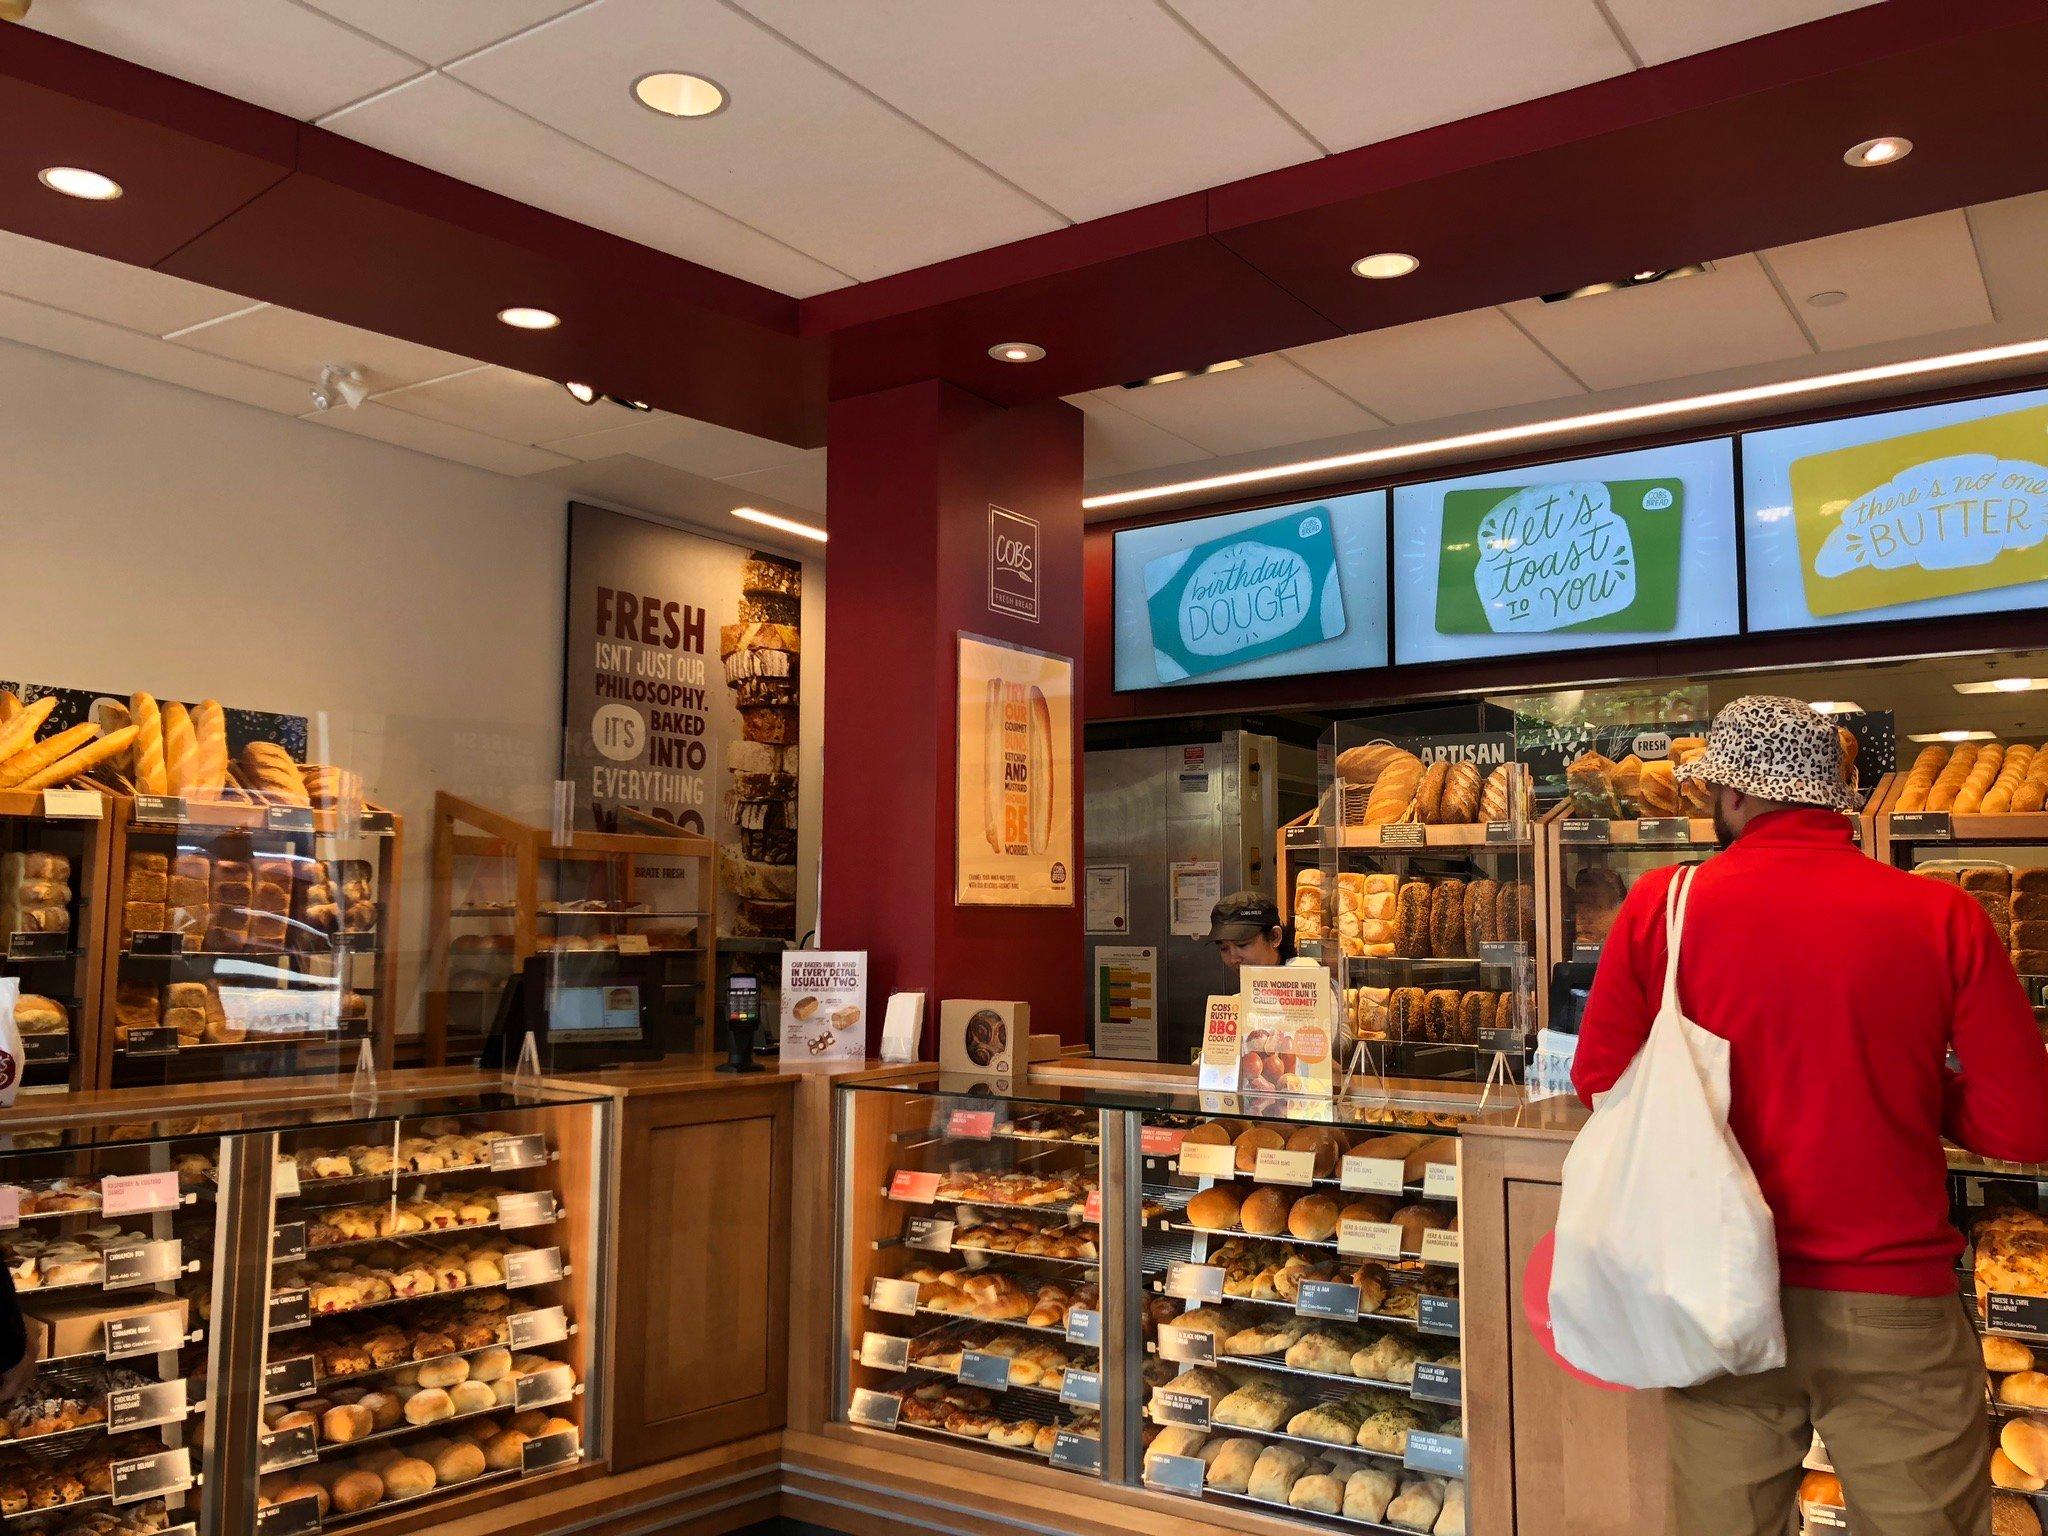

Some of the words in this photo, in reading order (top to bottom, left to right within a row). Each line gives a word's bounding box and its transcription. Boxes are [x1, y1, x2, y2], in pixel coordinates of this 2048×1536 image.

[1648, 492, 1667, 500] COBS
[1851, 479, 1946, 528] there's
[1953, 472, 1997, 493] no
[1645, 499, 1669, 507] BREAD
[1486, 490, 1604, 562] let's
[1869, 498, 2032, 558] BUTTER
[996, 535, 1033, 571] COBS
[1491, 522, 1614, 601] toast
[1192, 556, 1301, 602] birthday
[995, 592, 1014, 605] FRESH
[1014, 597, 1033, 611] BREAD
[1506, 599, 1530, 615] TO
[1188, 580, 1302, 642] DOUGH
[596, 586, 706, 655] FRESH
[595, 641, 632, 673] ISN'T
[637, 650, 673, 681] JUST
[677, 657, 705, 686] OUR
[595, 672, 709, 711] PHILOSOPHY.
[1005, 702, 1027, 721] OUR
[604, 717, 635, 748] IT'S
[651, 710, 705, 736] BAKED
[1004, 721, 1027, 733] GOURMET
[1005, 732, 1027, 752] BUNS
[1637, 739, 1667, 751] FRESH
[650, 736, 707, 771] INTO
[1420, 742, 1506, 764] ARTISAN
[1004, 763, 1027, 783] AND
[592, 765, 704, 805] EVERYTHING
[1005, 805, 1027, 844] BE
[791, 968, 799, 976] IN
[803, 968, 827, 976] EVERY
[830, 968, 859, 976] DETAIL.
[791, 978, 830, 987] USUALLY
[833, 978, 859, 987] TWO.
[1270, 981, 1299, 989] WONDER
[1261, 989, 1294, 997] GOURMET
[1296, 990, 1309, 998] BUN
[1311, 990, 1317, 998] IS
[1211, 1003, 1230, 1011] COBS
[1253, 997, 1277, 1005] CALLED
[1279, 998, 1318, 1007] GOURMET?
[1210, 1012, 1238, 1020] RUSTY'S
[1209, 1020, 1237, 1035] BBQ
[1207, 1035, 1236, 1043] COOK-OFF
[109, 1251, 133, 1261] CINNAMON
[1991, 1297, 2009, 1305] CHEESE
[112, 1328, 138, 1338] CINNAMON
[1418, 1366, 1434, 1374] ITALIAN
[1418, 1372, 1435, 1381] TURKISH
[1435, 1376, 1448, 1384] BREAD
[114, 1394, 141, 1404] CHOCOLATE
[114, 1401, 140, 1412] CROISSANT
[1410, 1434, 1426, 1443] ITALIAN
[1410, 1442, 1428, 1450] TURKISH
[1428, 1445, 1442, 1453] BREAD
[117, 1464, 136, 1474] APRICOT
